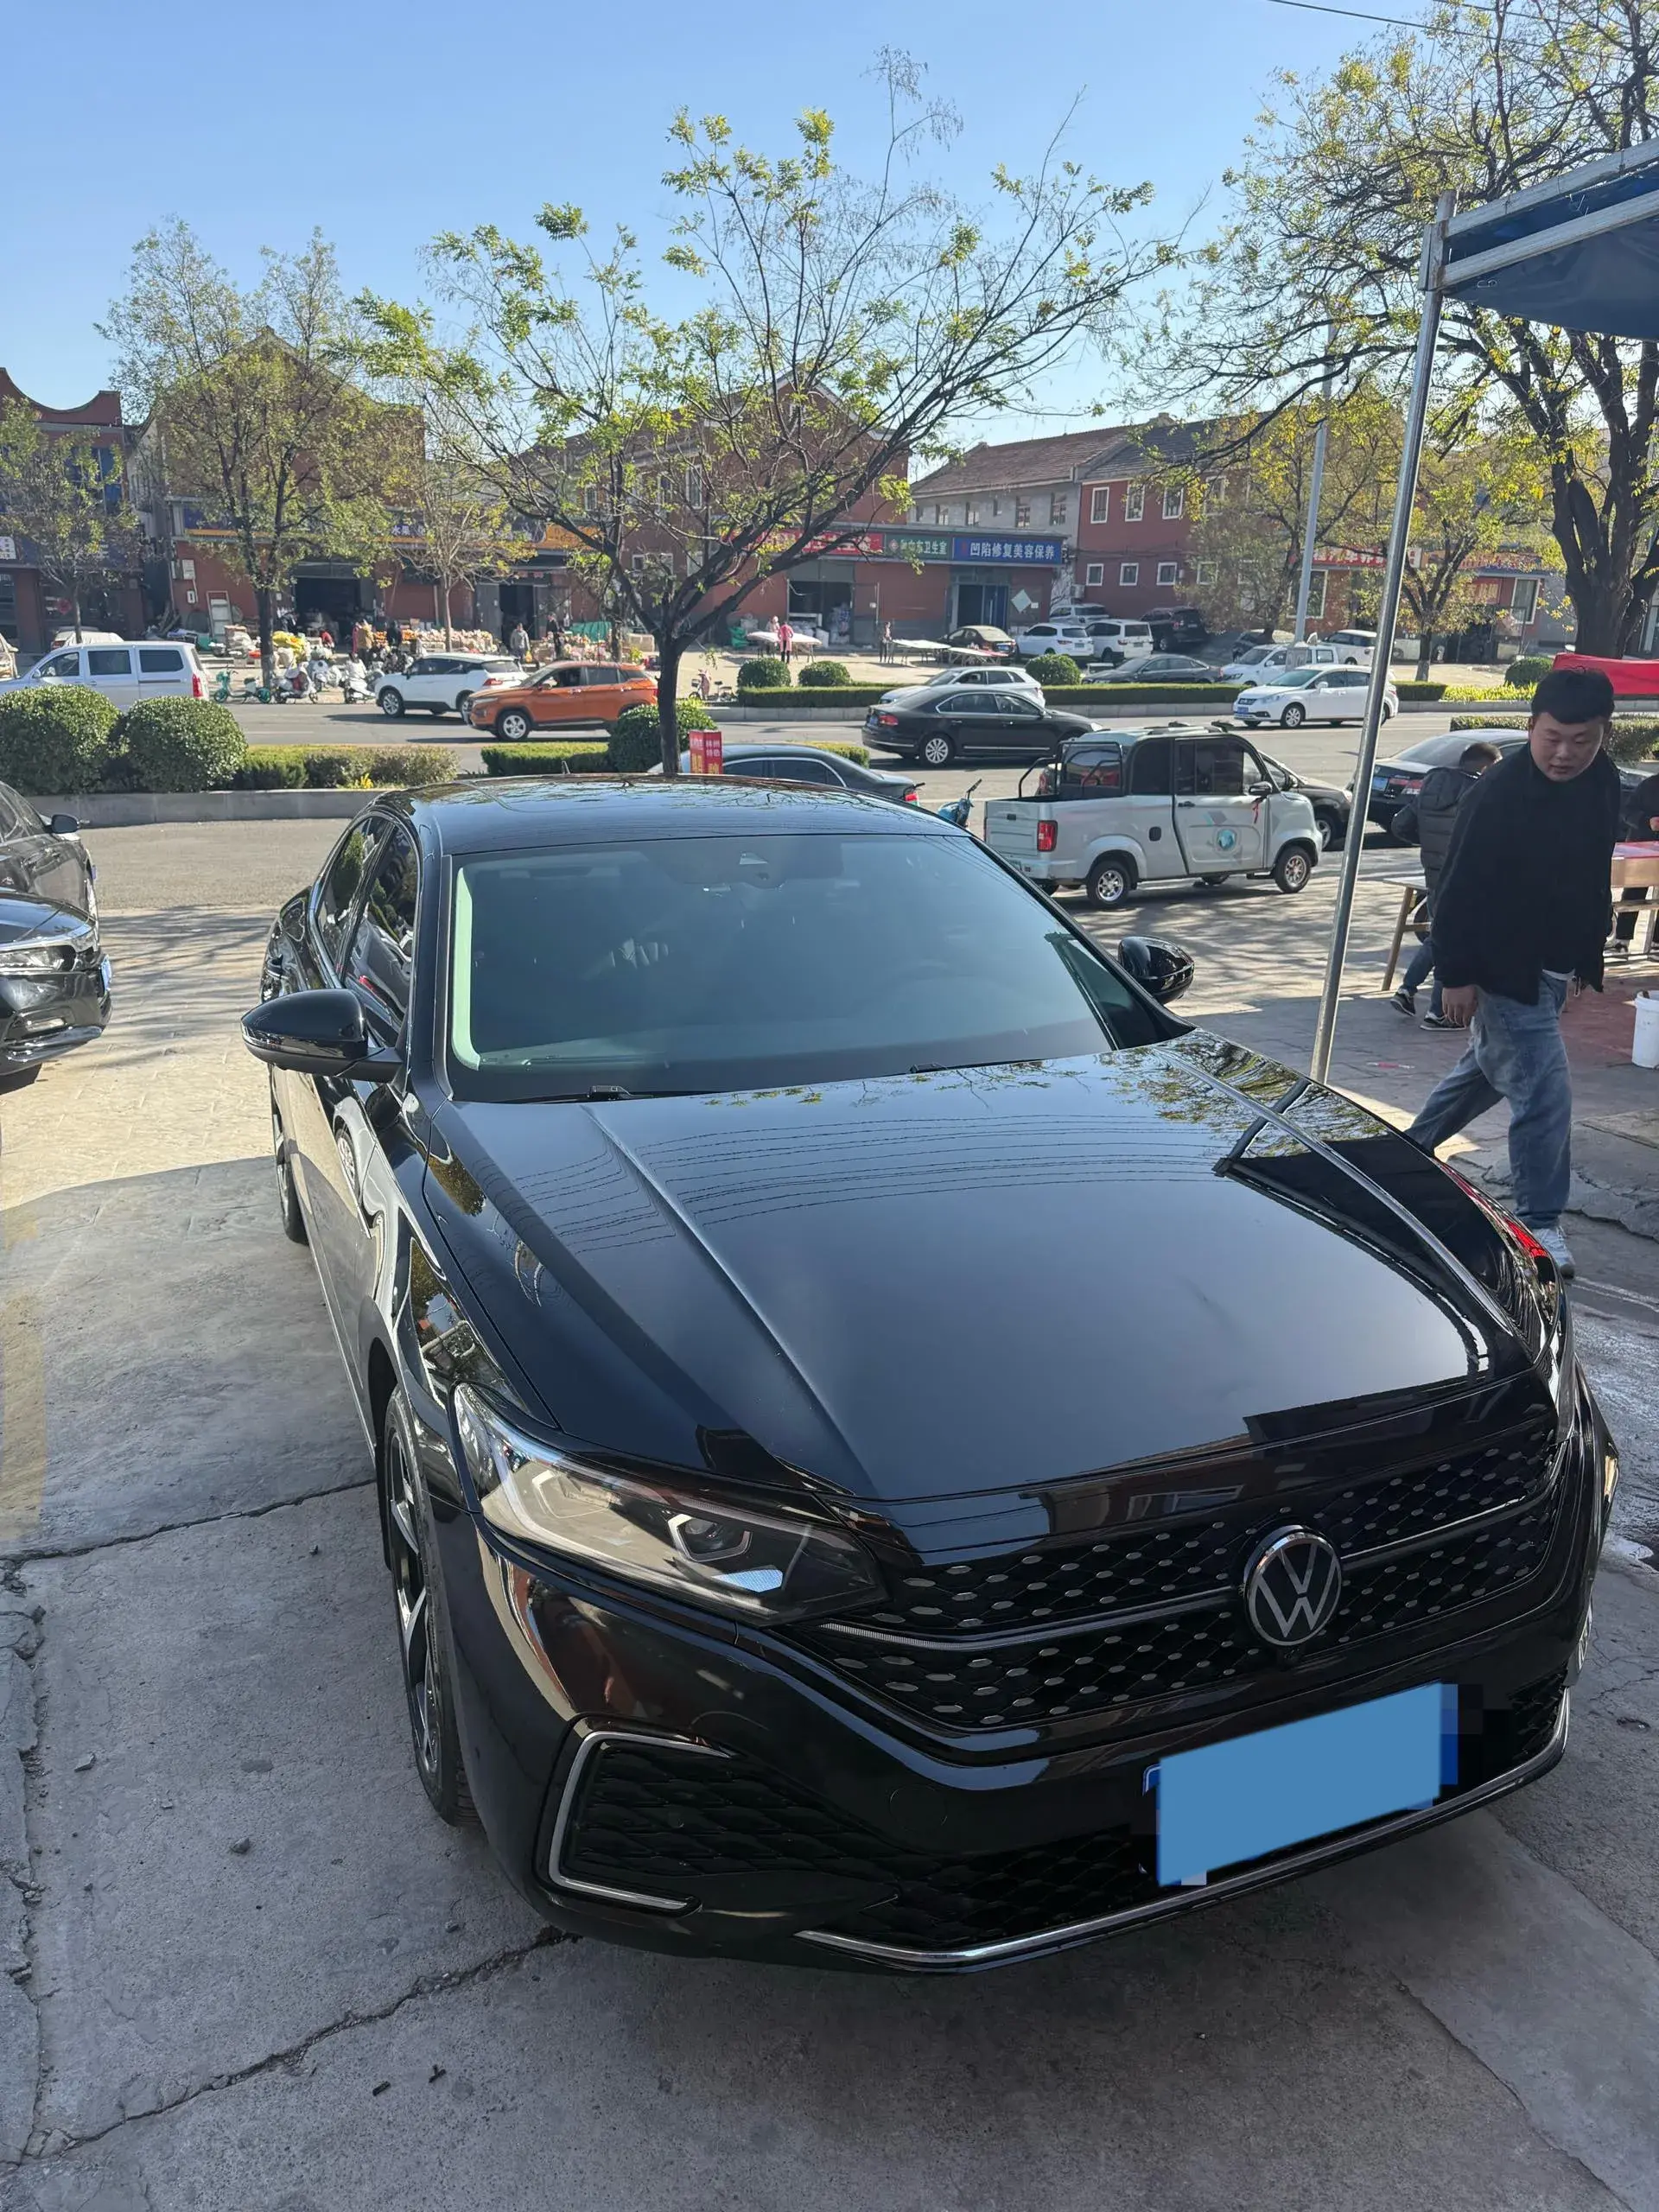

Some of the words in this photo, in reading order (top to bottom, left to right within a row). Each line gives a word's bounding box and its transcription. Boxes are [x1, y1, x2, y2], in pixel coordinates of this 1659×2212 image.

[969, 542, 1055, 560] 凹陷修复美容保养
[1253, 1541, 1340, 1639] VW
